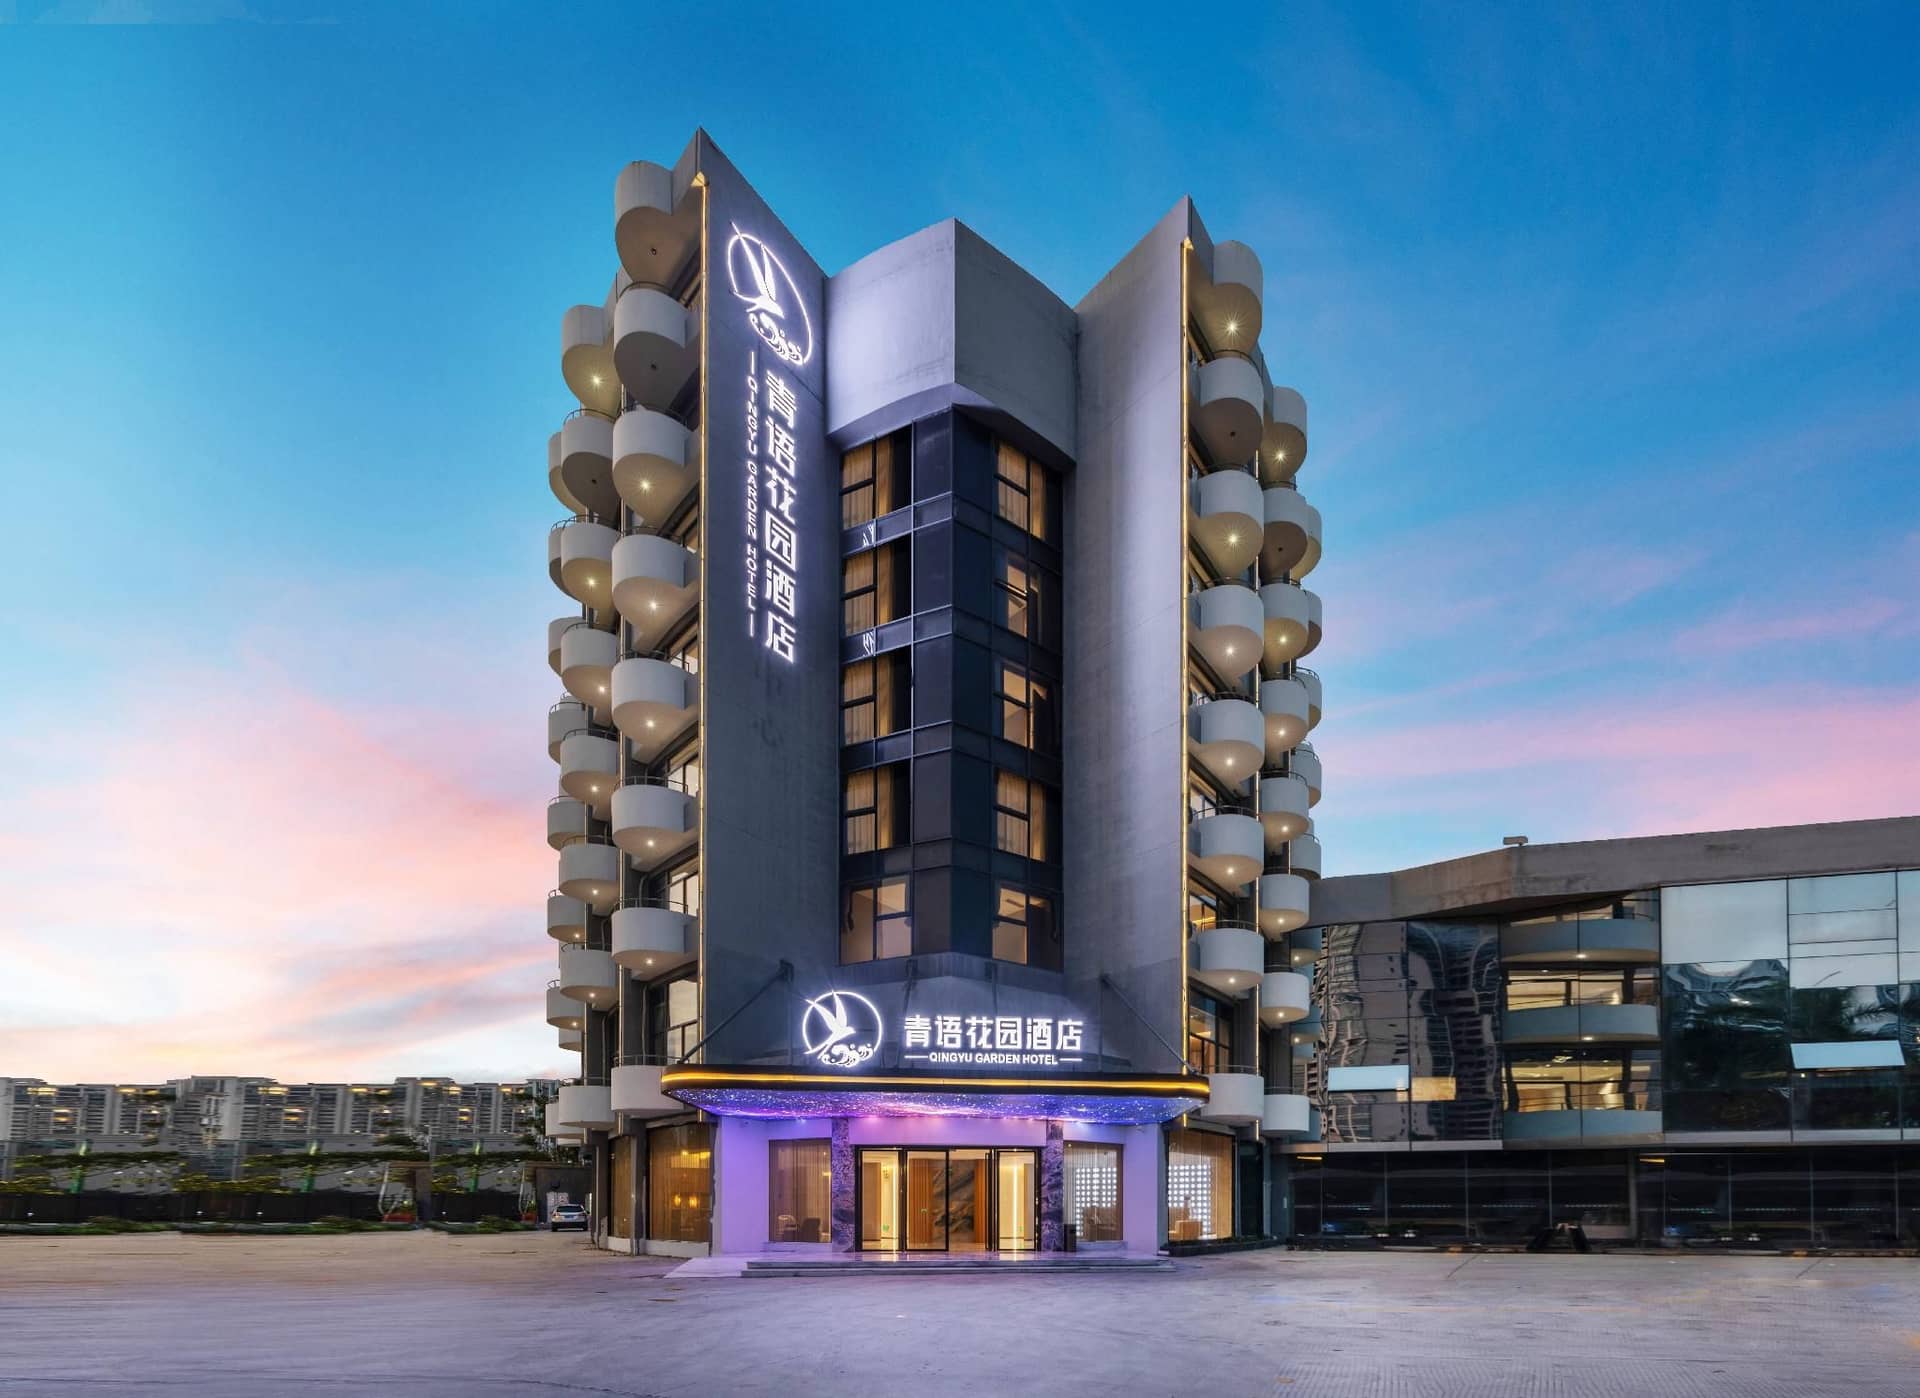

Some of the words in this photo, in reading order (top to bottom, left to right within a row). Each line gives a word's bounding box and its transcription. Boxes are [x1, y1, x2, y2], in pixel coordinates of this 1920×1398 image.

[747, 375, 758, 455] QINGYU
[747, 460, 758, 540] GARDEN
[765, 369, 797, 662] 青语花园酒店
[747, 543, 758, 611] HOTEL
[904, 1014, 1083, 1051] 青语花园酒店
[929, 1052, 972, 1062] QINGYU
[975, 1053, 1020, 1064] GARDEN
[1022, 1054, 1059, 1065] HOTEL
